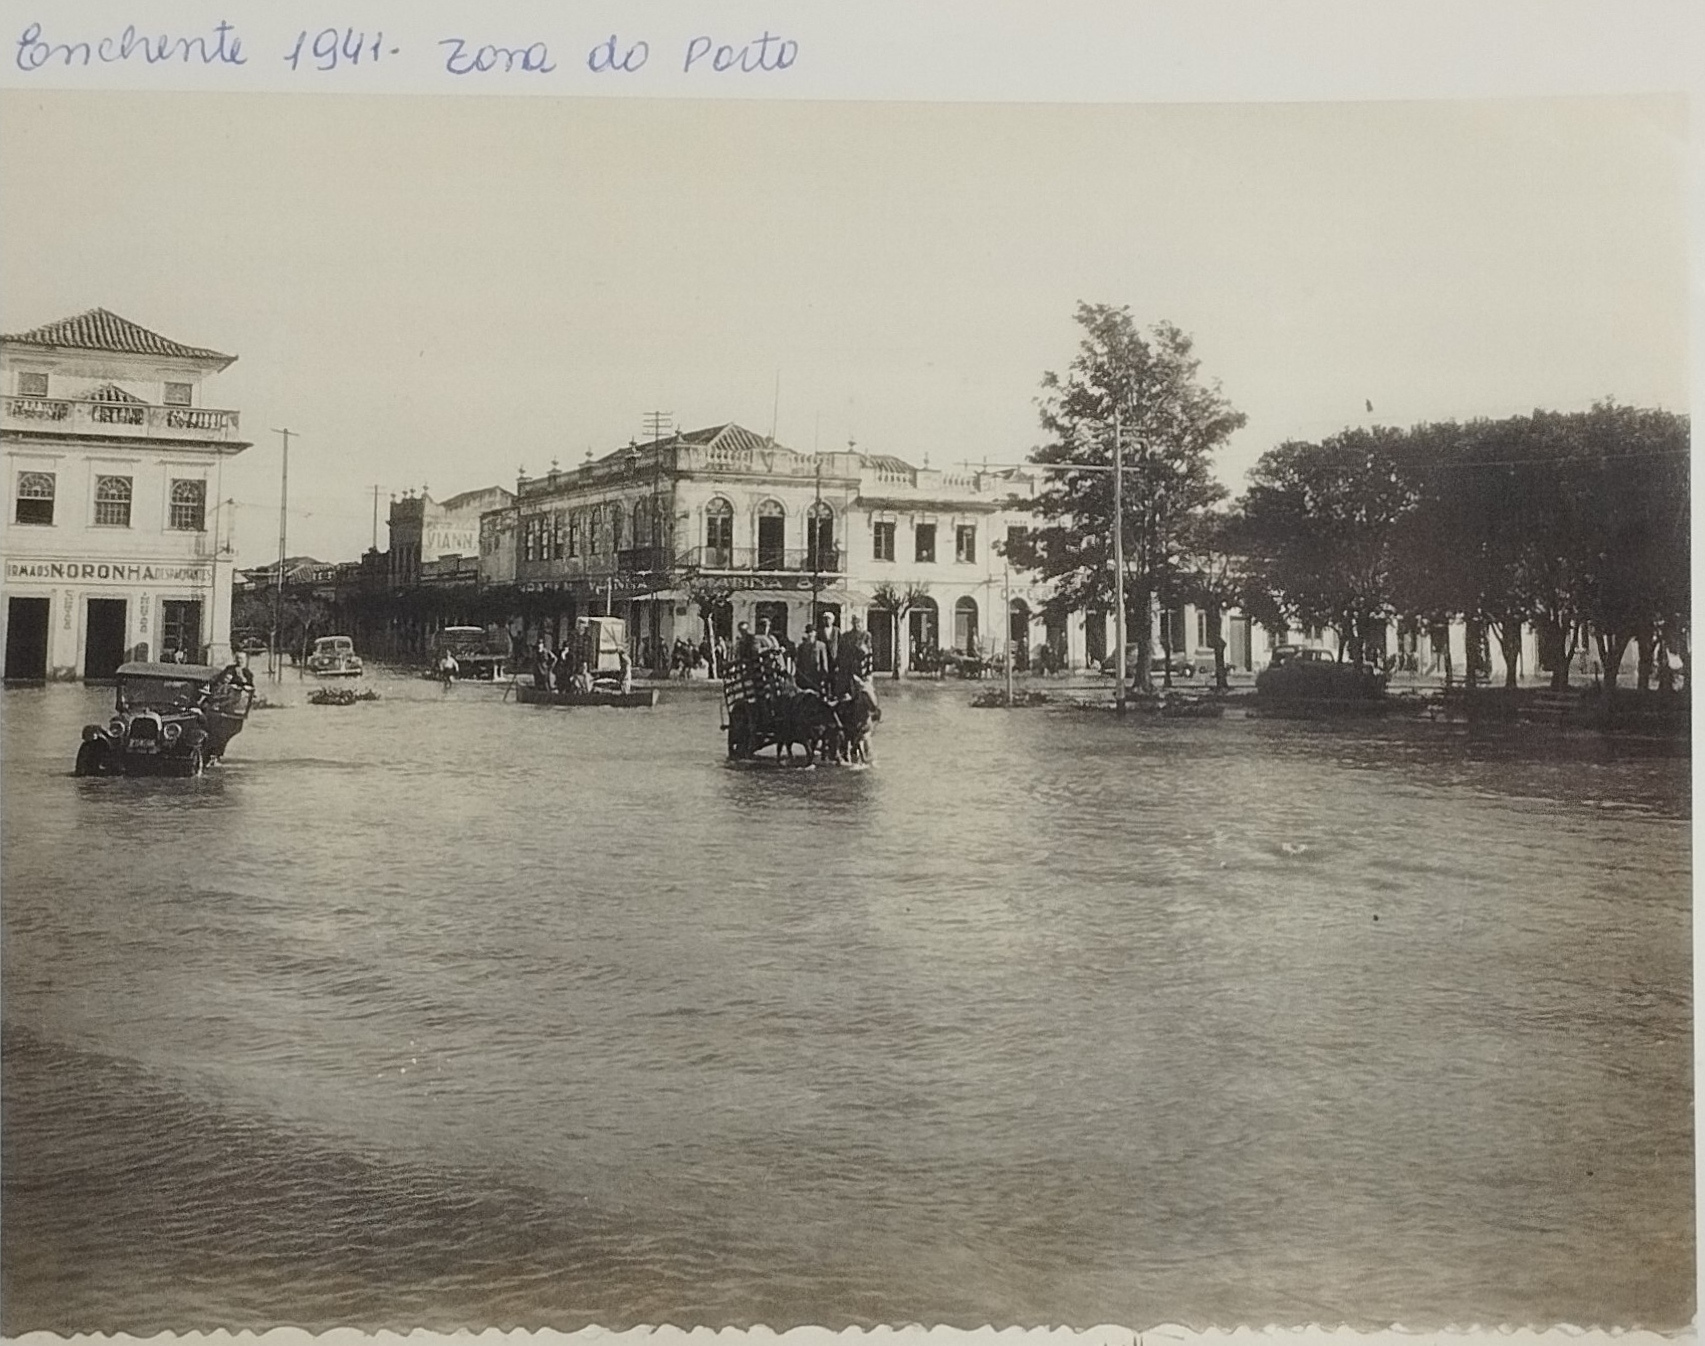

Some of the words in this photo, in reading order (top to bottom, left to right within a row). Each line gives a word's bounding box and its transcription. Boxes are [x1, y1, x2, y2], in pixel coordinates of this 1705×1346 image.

[16, 20, 248, 72] Enchente
[586, 34, 650, 73] do
[683, 31, 800, 73] Porto
[50, 563, 154, 581] NORONHA
